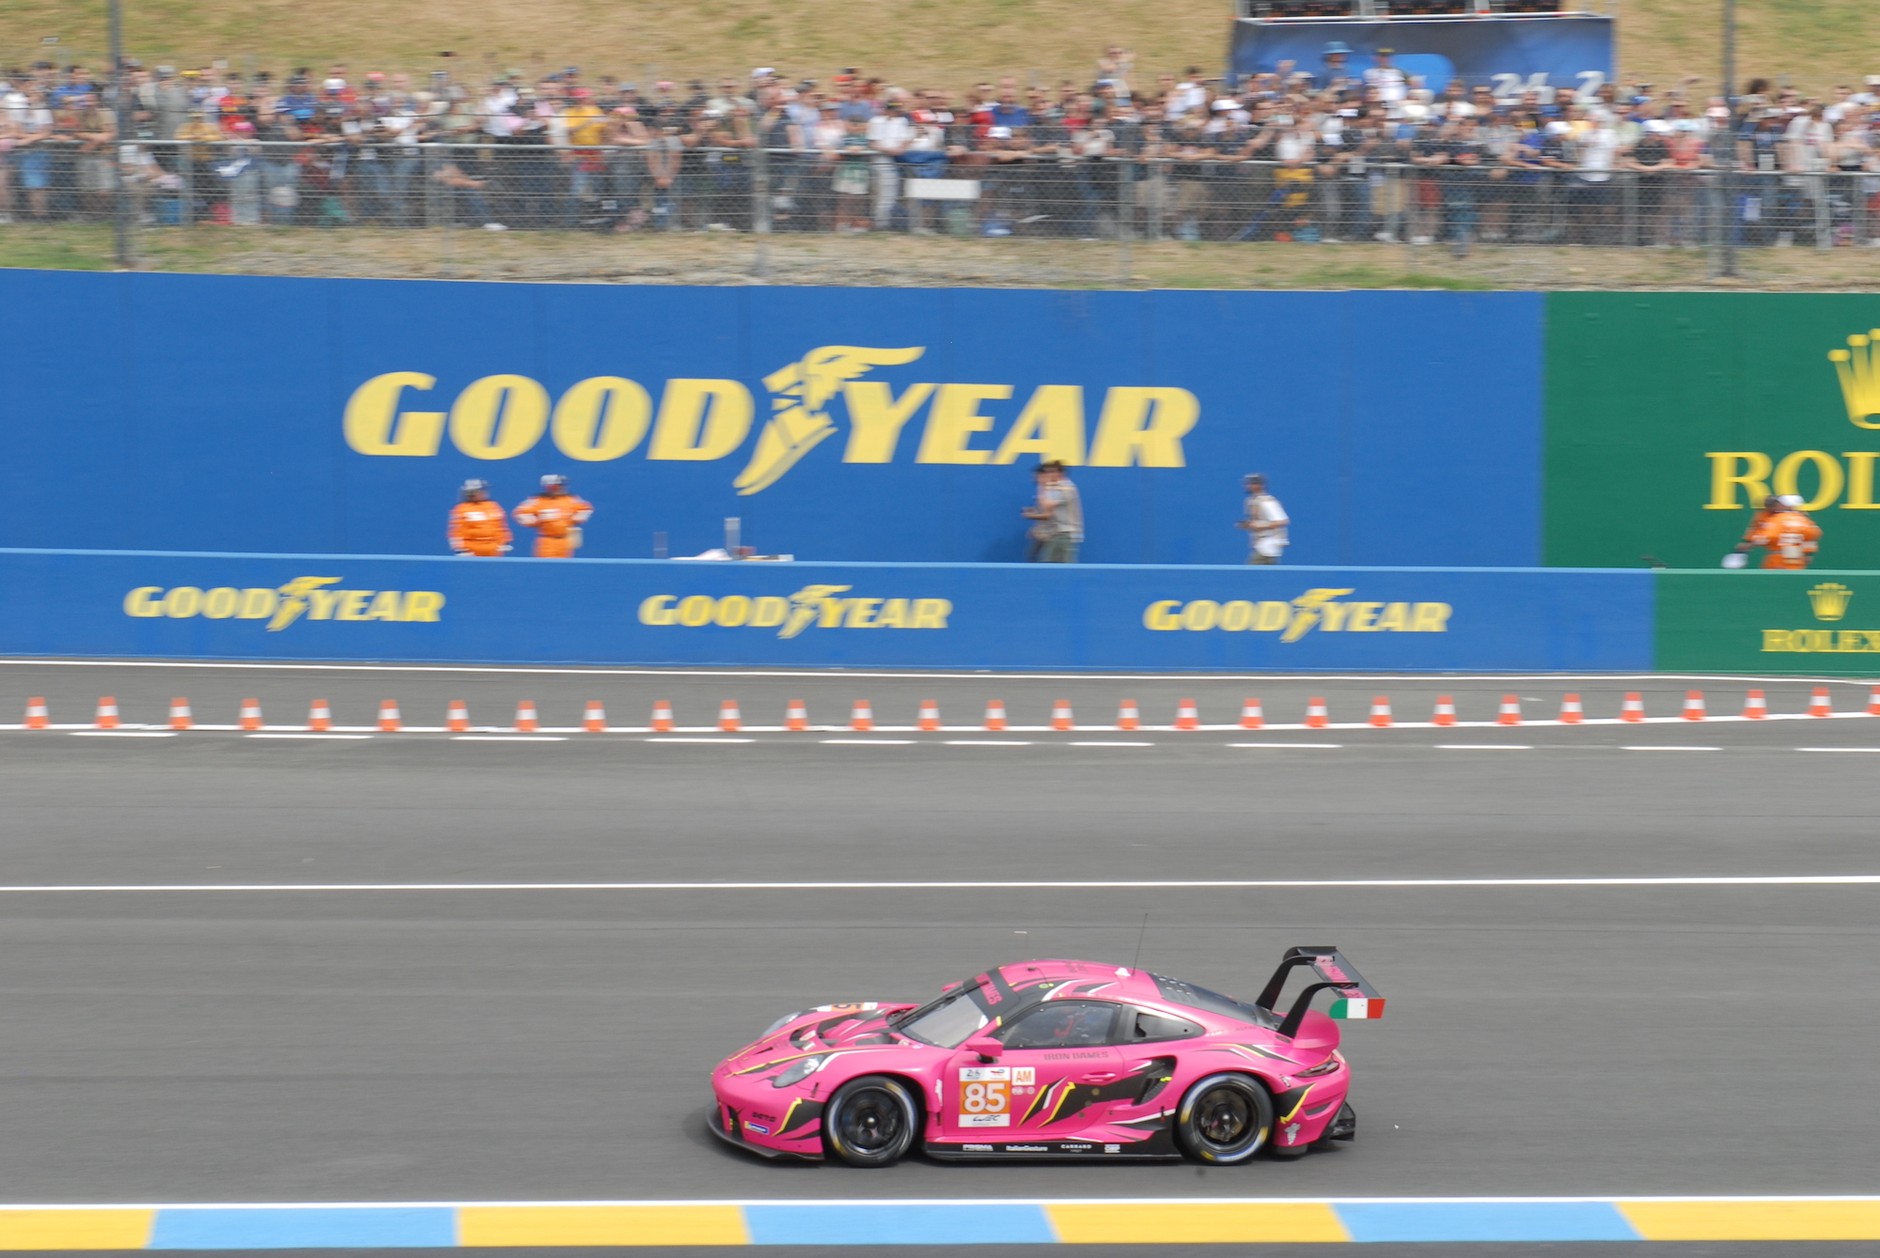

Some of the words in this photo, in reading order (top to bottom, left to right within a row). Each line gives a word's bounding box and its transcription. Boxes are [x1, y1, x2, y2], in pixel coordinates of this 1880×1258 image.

[343, 370, 1200, 468] GOODYEAR
[123, 585, 446, 622] GOODYEAR
[638, 594, 953, 629] GOODYEAR
[1142, 599, 1453, 633] GOODYEAR
[1015, 1070, 1032, 1083] AM
[963, 1082, 1006, 1113] 85
